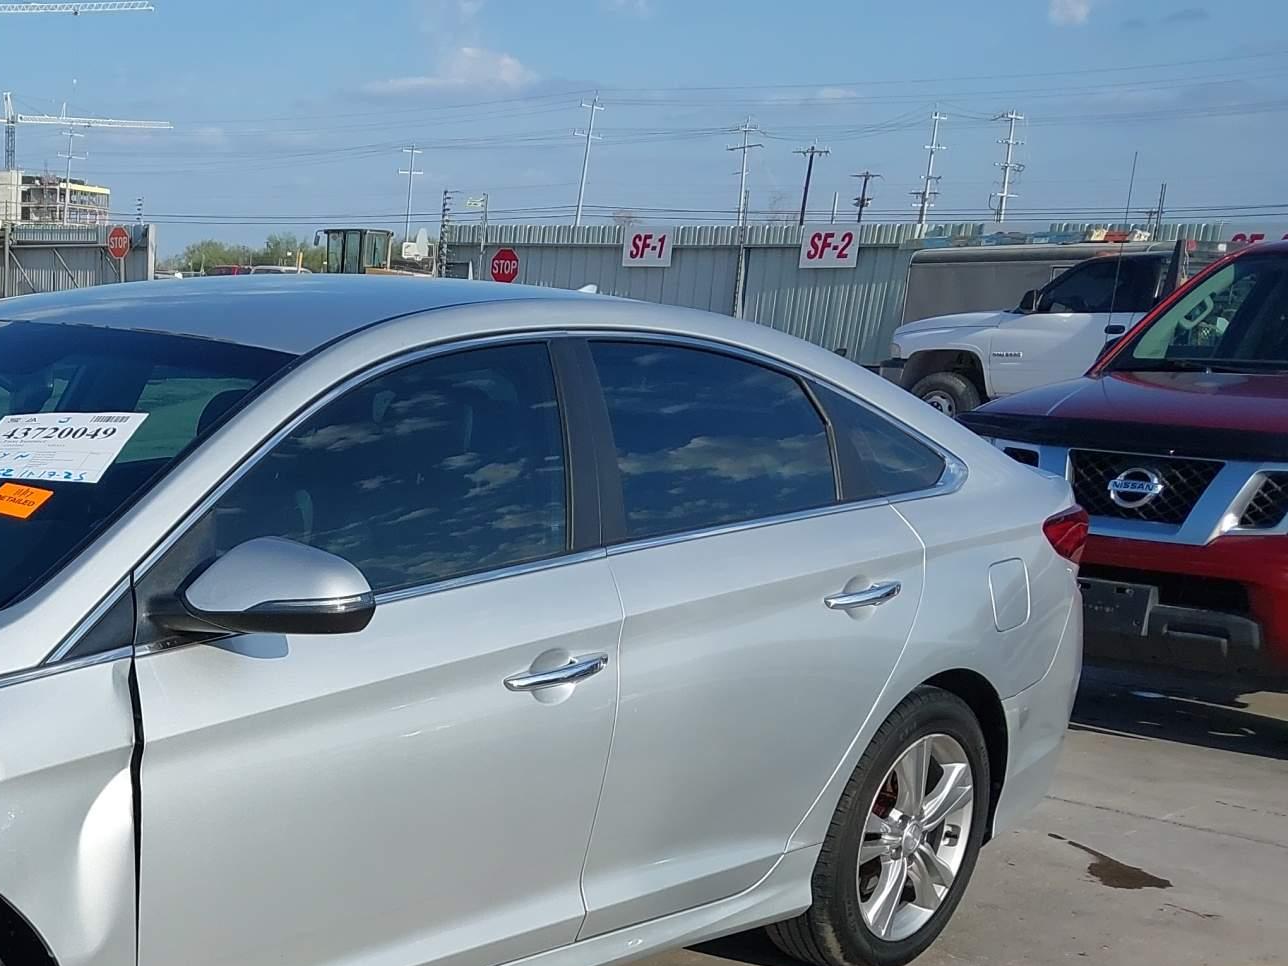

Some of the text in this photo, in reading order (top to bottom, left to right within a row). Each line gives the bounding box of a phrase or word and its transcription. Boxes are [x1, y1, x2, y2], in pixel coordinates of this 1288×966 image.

[110, 236, 128, 249] STOP
[629, 233, 666, 259] SF-1
[807, 232, 853, 259] SF-2
[492, 260, 517, 274] STOP
[2, 427, 117, 440] 43720049
[1112, 481, 1154, 491] NISSAN
